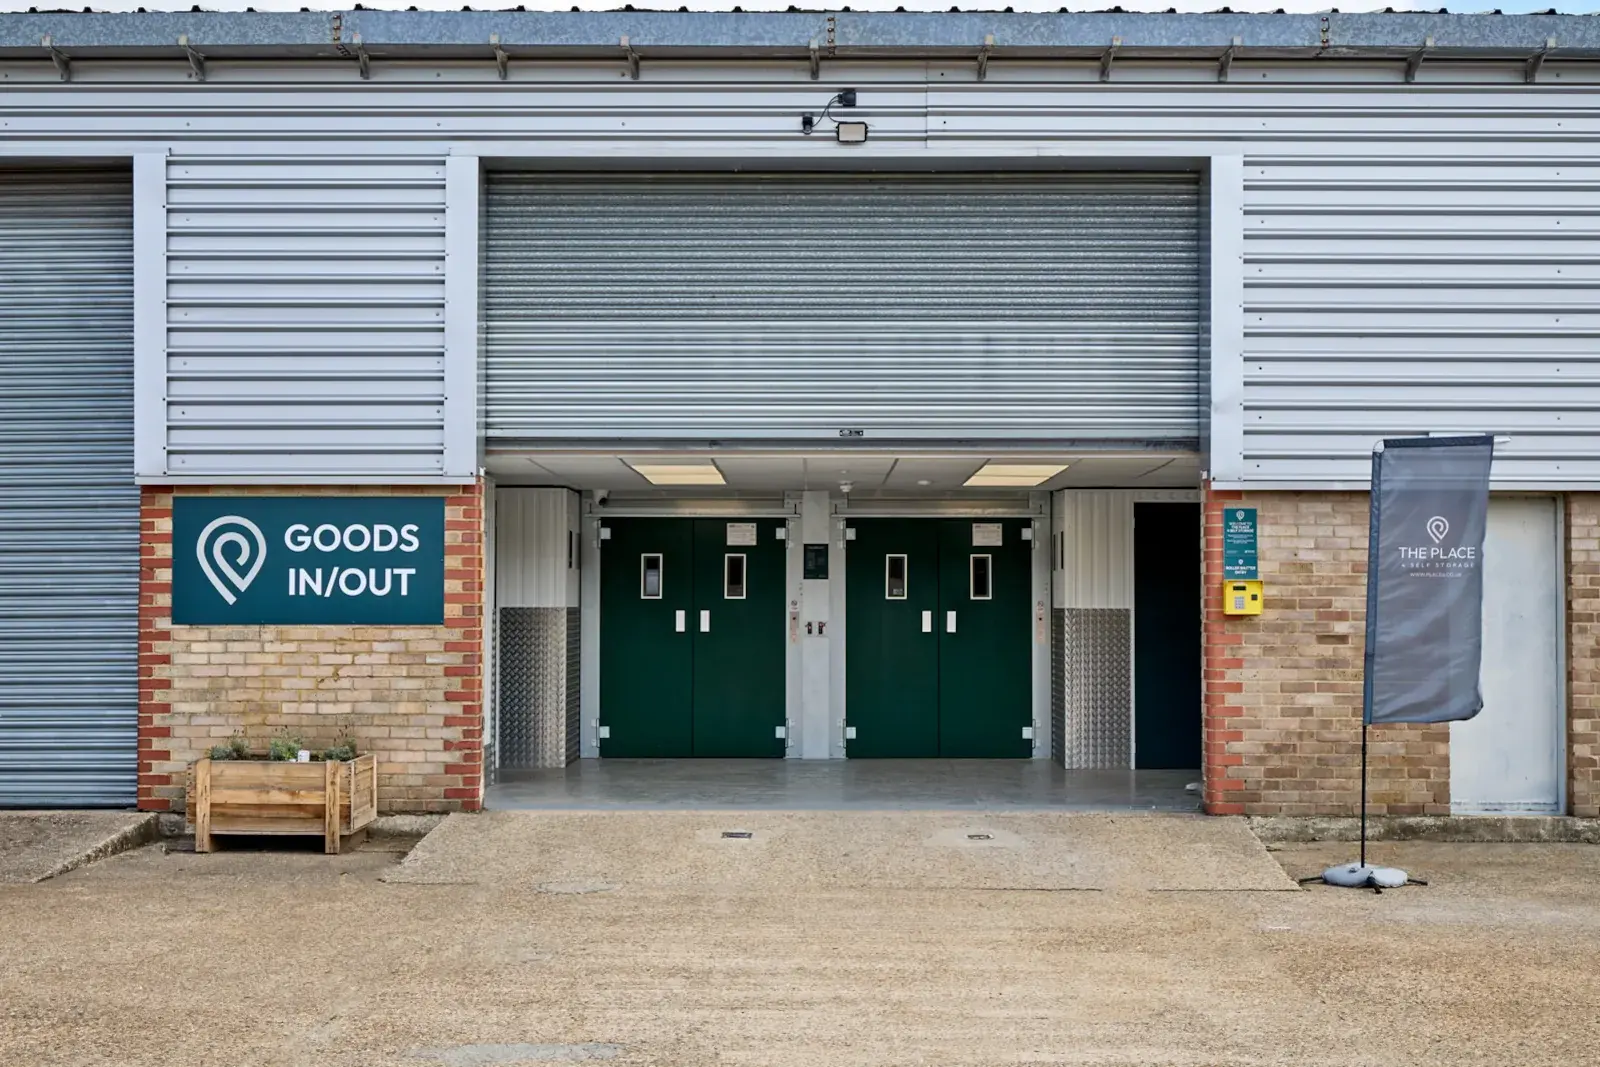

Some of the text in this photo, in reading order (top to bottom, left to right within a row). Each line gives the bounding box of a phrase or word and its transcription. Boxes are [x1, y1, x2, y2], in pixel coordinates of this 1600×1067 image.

[284, 523, 420, 553] GOODS
[1398, 546, 1475, 559] THE PLACE
[288, 566, 416, 598] IN/OUT
